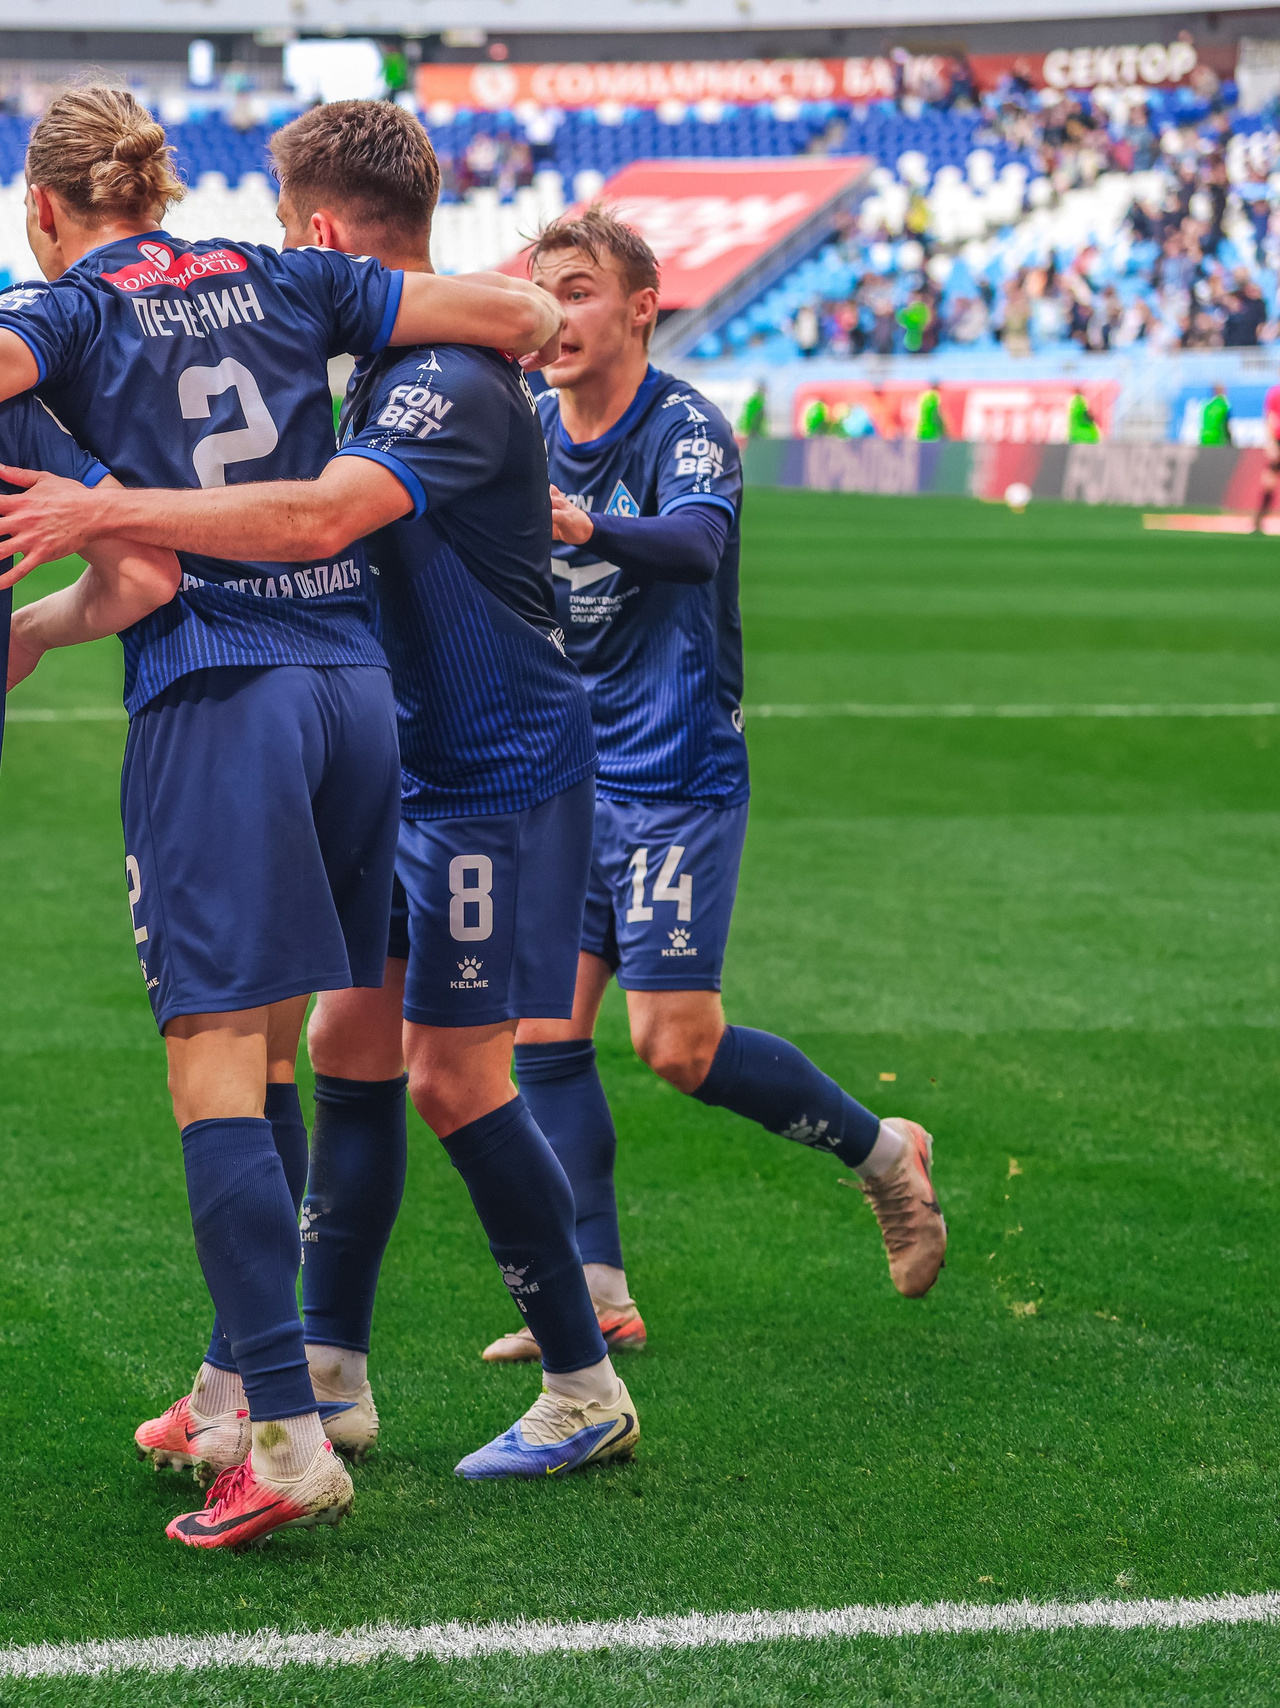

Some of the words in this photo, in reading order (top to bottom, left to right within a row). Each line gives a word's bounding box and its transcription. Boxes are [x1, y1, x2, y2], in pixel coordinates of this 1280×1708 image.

[1042, 42, 1198, 89] СЕКТОР
[131, 283, 266, 339] ПЕЧЕНИН
[388, 384, 454, 421] FON
[177, 356, 279, 490] 2
[377, 404, 442, 440] BET
[675, 438, 724, 465] FON
[675, 457, 724, 479] BET
[448, 854, 494, 942] 8
[626, 845, 693, 924] 14
[661, 948, 698, 957] KELME
[450, 979, 489, 989] KELME
[505, 1282, 540, 1295] LME
